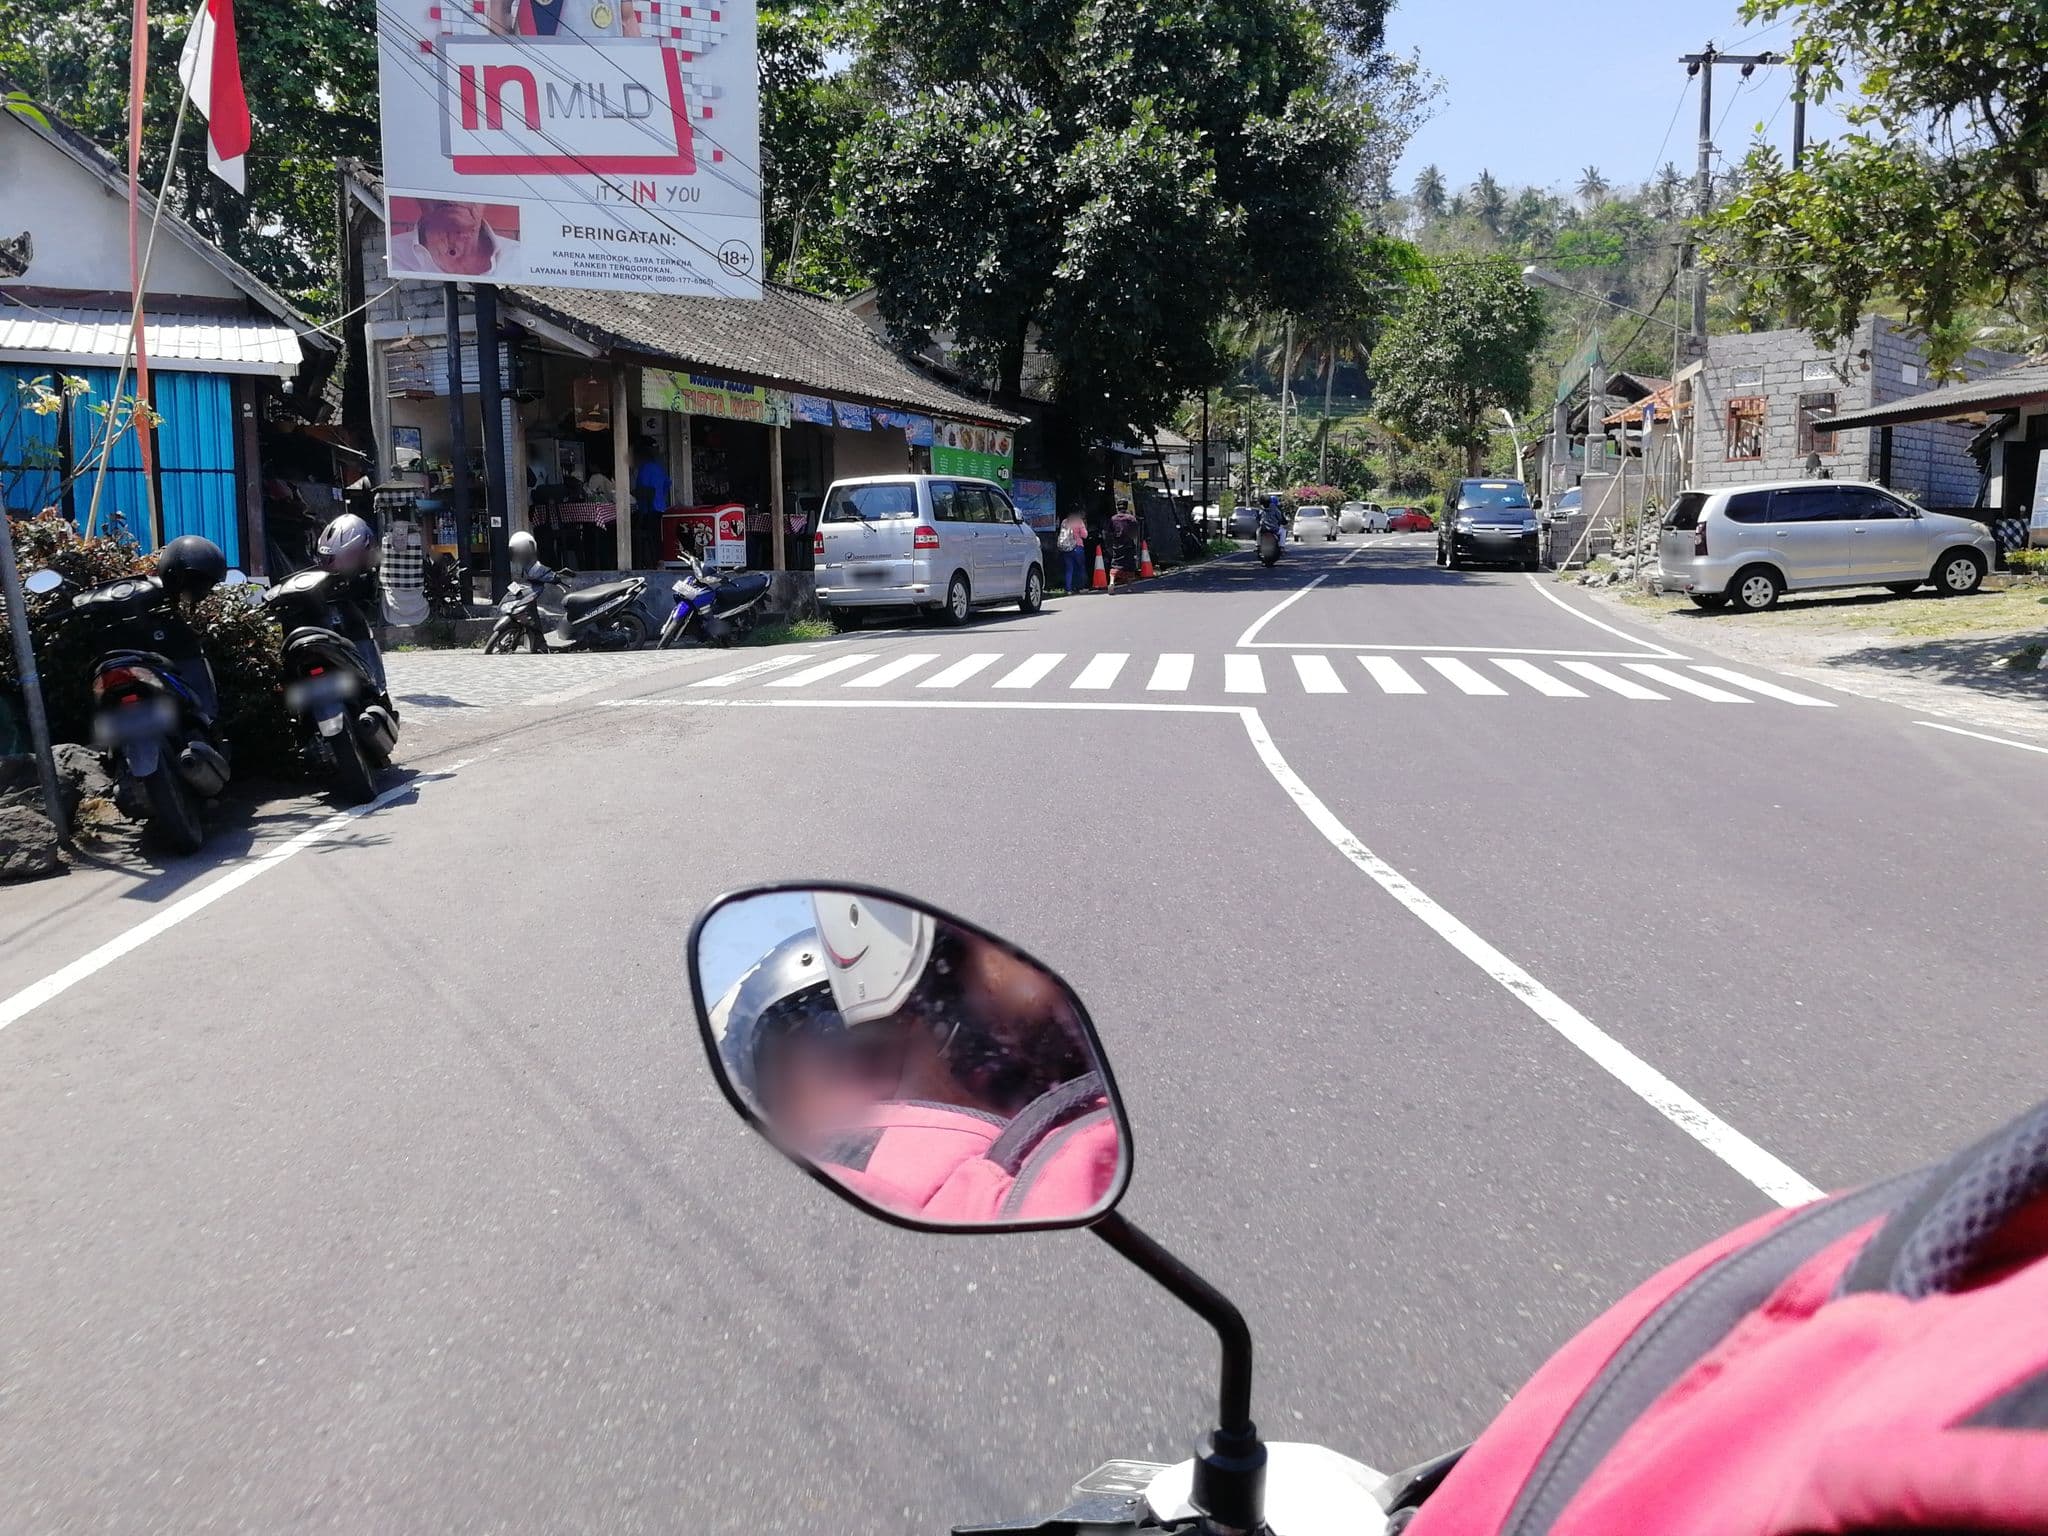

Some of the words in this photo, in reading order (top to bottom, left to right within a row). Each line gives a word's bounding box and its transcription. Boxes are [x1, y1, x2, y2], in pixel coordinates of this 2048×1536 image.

[546, 82, 654, 119] MILD
[632, 180, 657, 203] IN
[666, 186, 701, 203] YOU
[562, 225, 676, 246] PERINGATAN:
[552, 250, 586, 260] KARENA
[588, 252, 632, 264] MEROKOK,
[634, 256, 654, 265] SAYA
[656, 257, 692, 268] TERKENA
[573, 260, 607, 270] KANKER
[722, 251, 749, 265] 18+
[530, 267, 568, 276] LAYANAN
[569, 269, 611, 278] BERHENTI
[612, 271, 653, 282] MEROKOK
[681, 388, 725, 416] TIRTA
[729, 398, 764, 420] WATI
